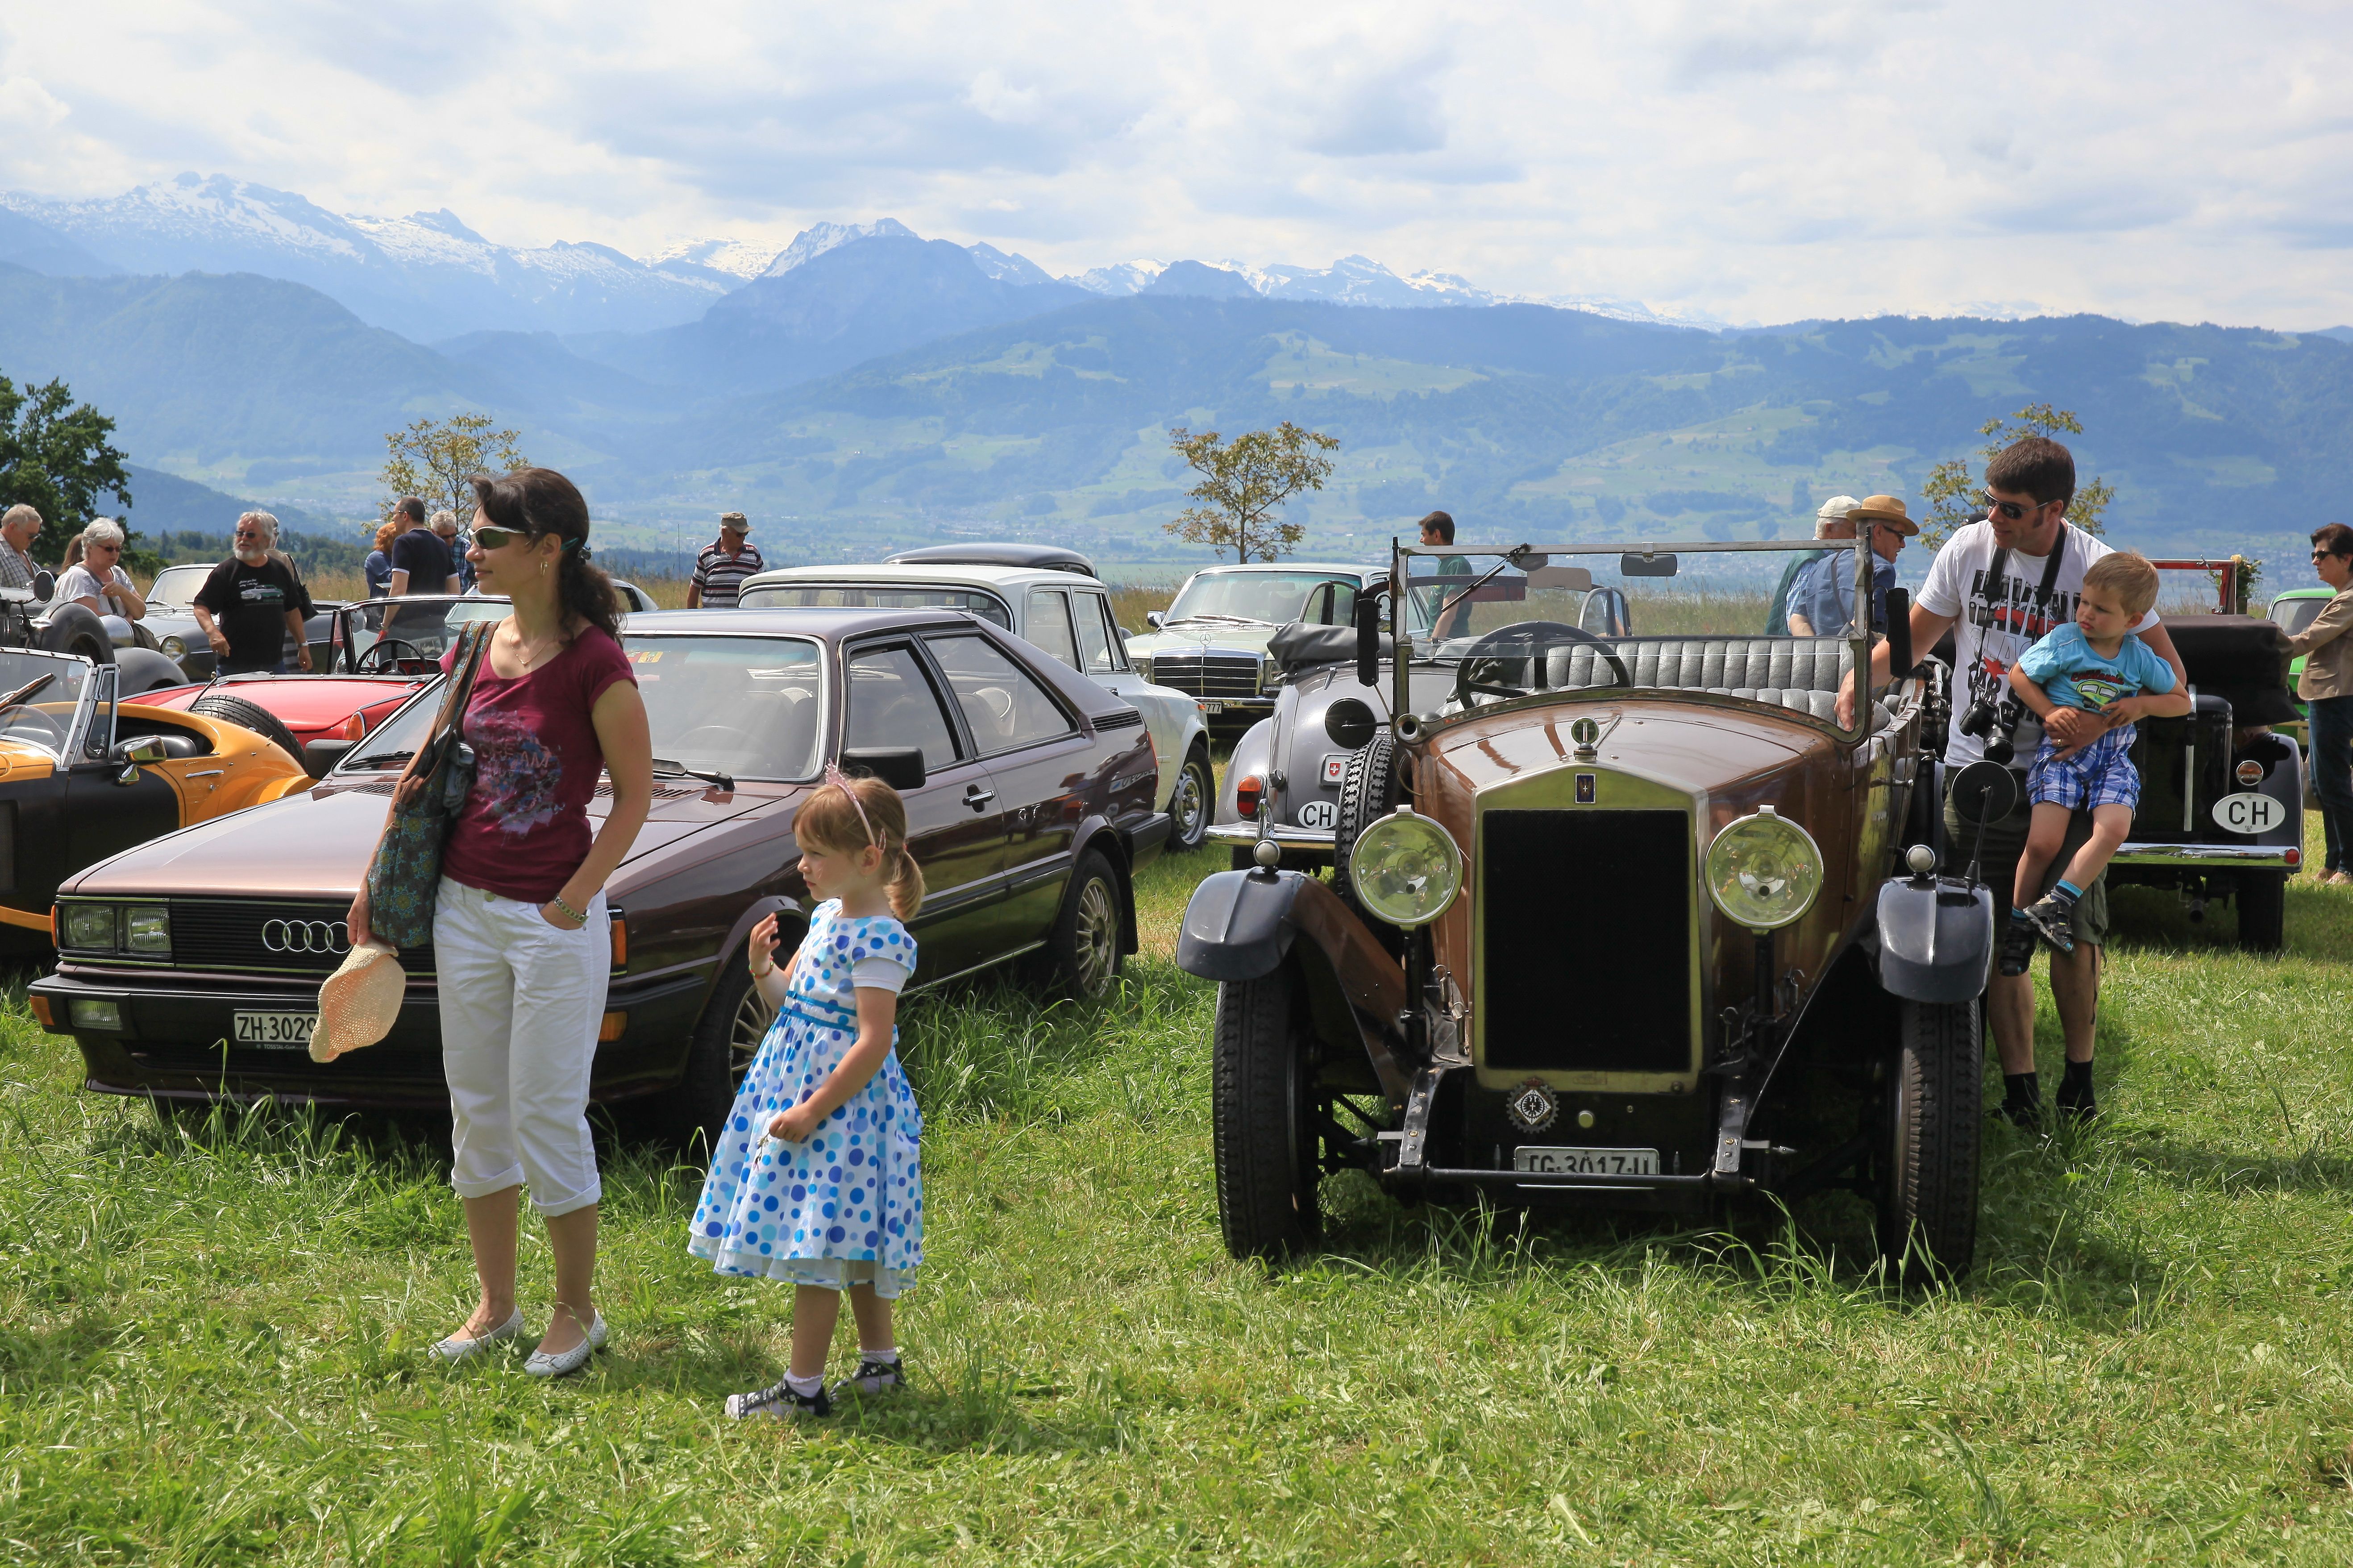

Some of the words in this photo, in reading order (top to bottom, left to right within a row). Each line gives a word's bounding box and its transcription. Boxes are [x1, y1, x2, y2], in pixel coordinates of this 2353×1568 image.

[1969, 569, 2081, 643] HAVAN
[1304, 805, 1332, 826] CH
[2229, 801, 2268, 825] CH
